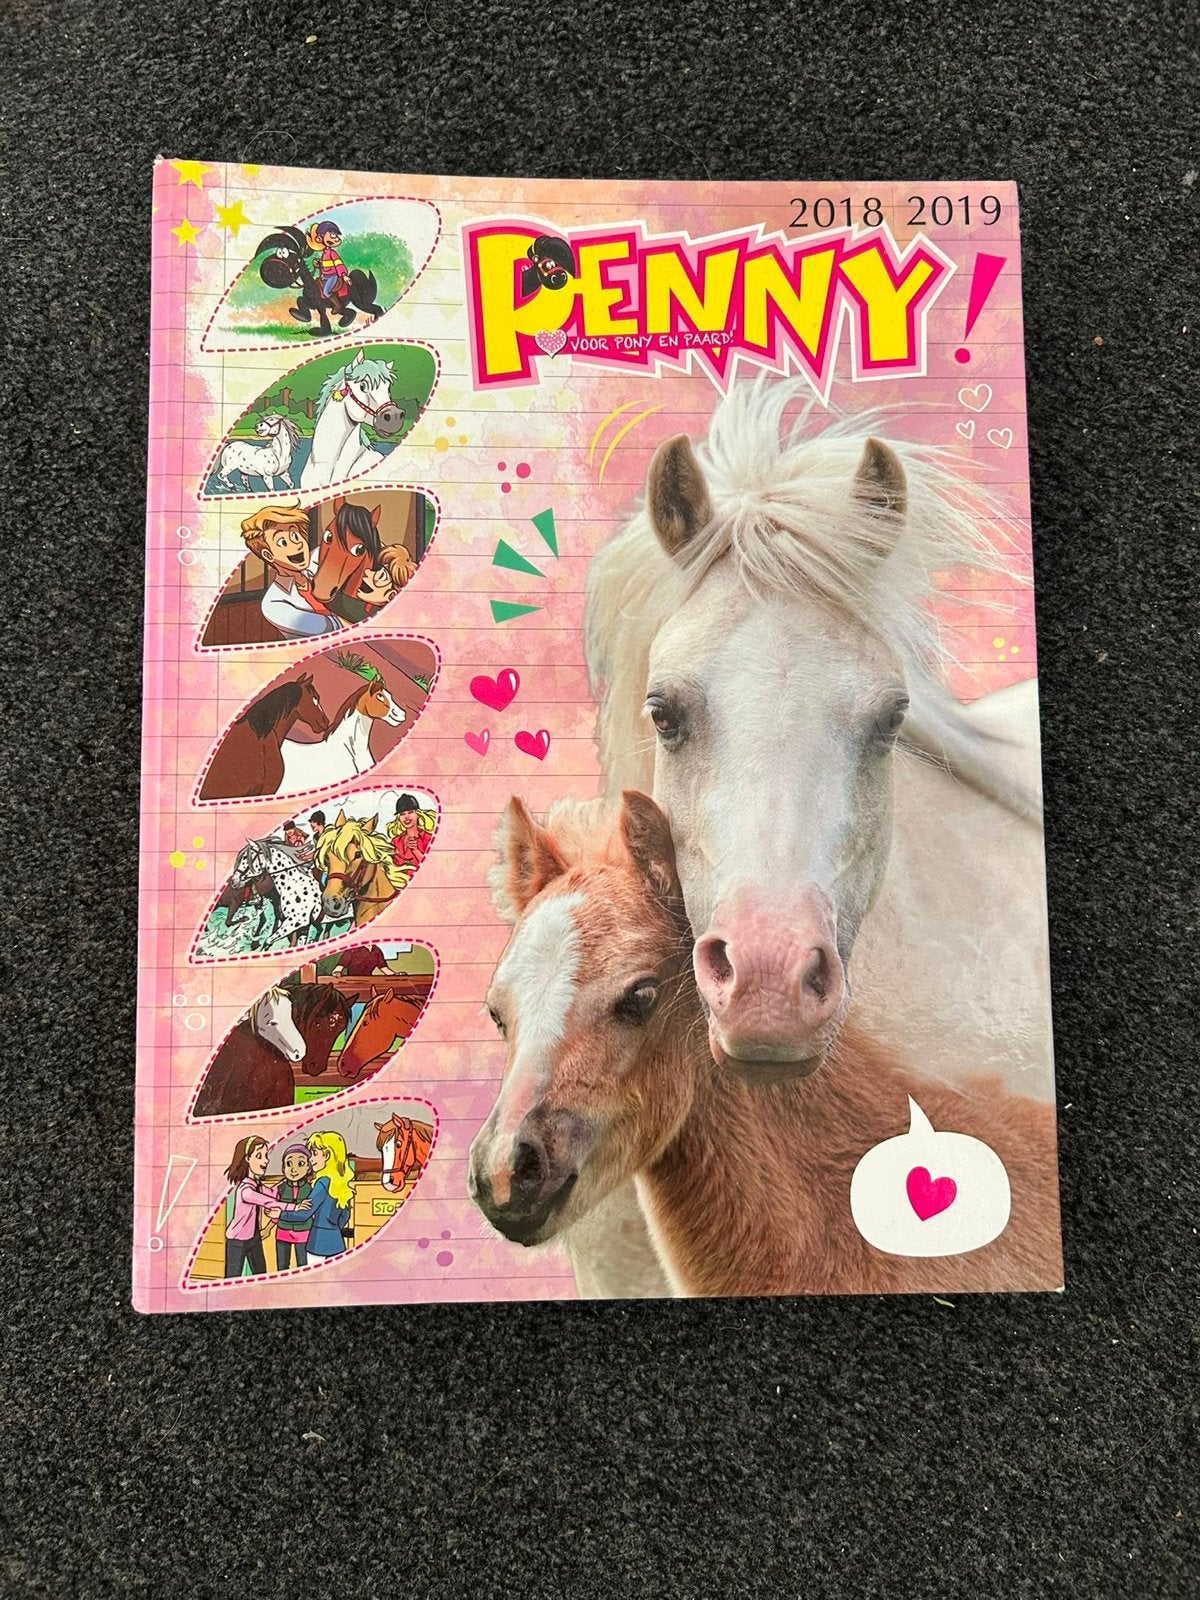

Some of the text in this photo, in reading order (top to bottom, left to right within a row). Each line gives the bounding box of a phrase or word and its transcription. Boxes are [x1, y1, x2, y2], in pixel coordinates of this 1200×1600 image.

[788, 195, 1002, 228] 2018 2019
[469, 227, 944, 390] PENNY
[570, 330, 735, 351] VOOR PONY EN PAARD!
